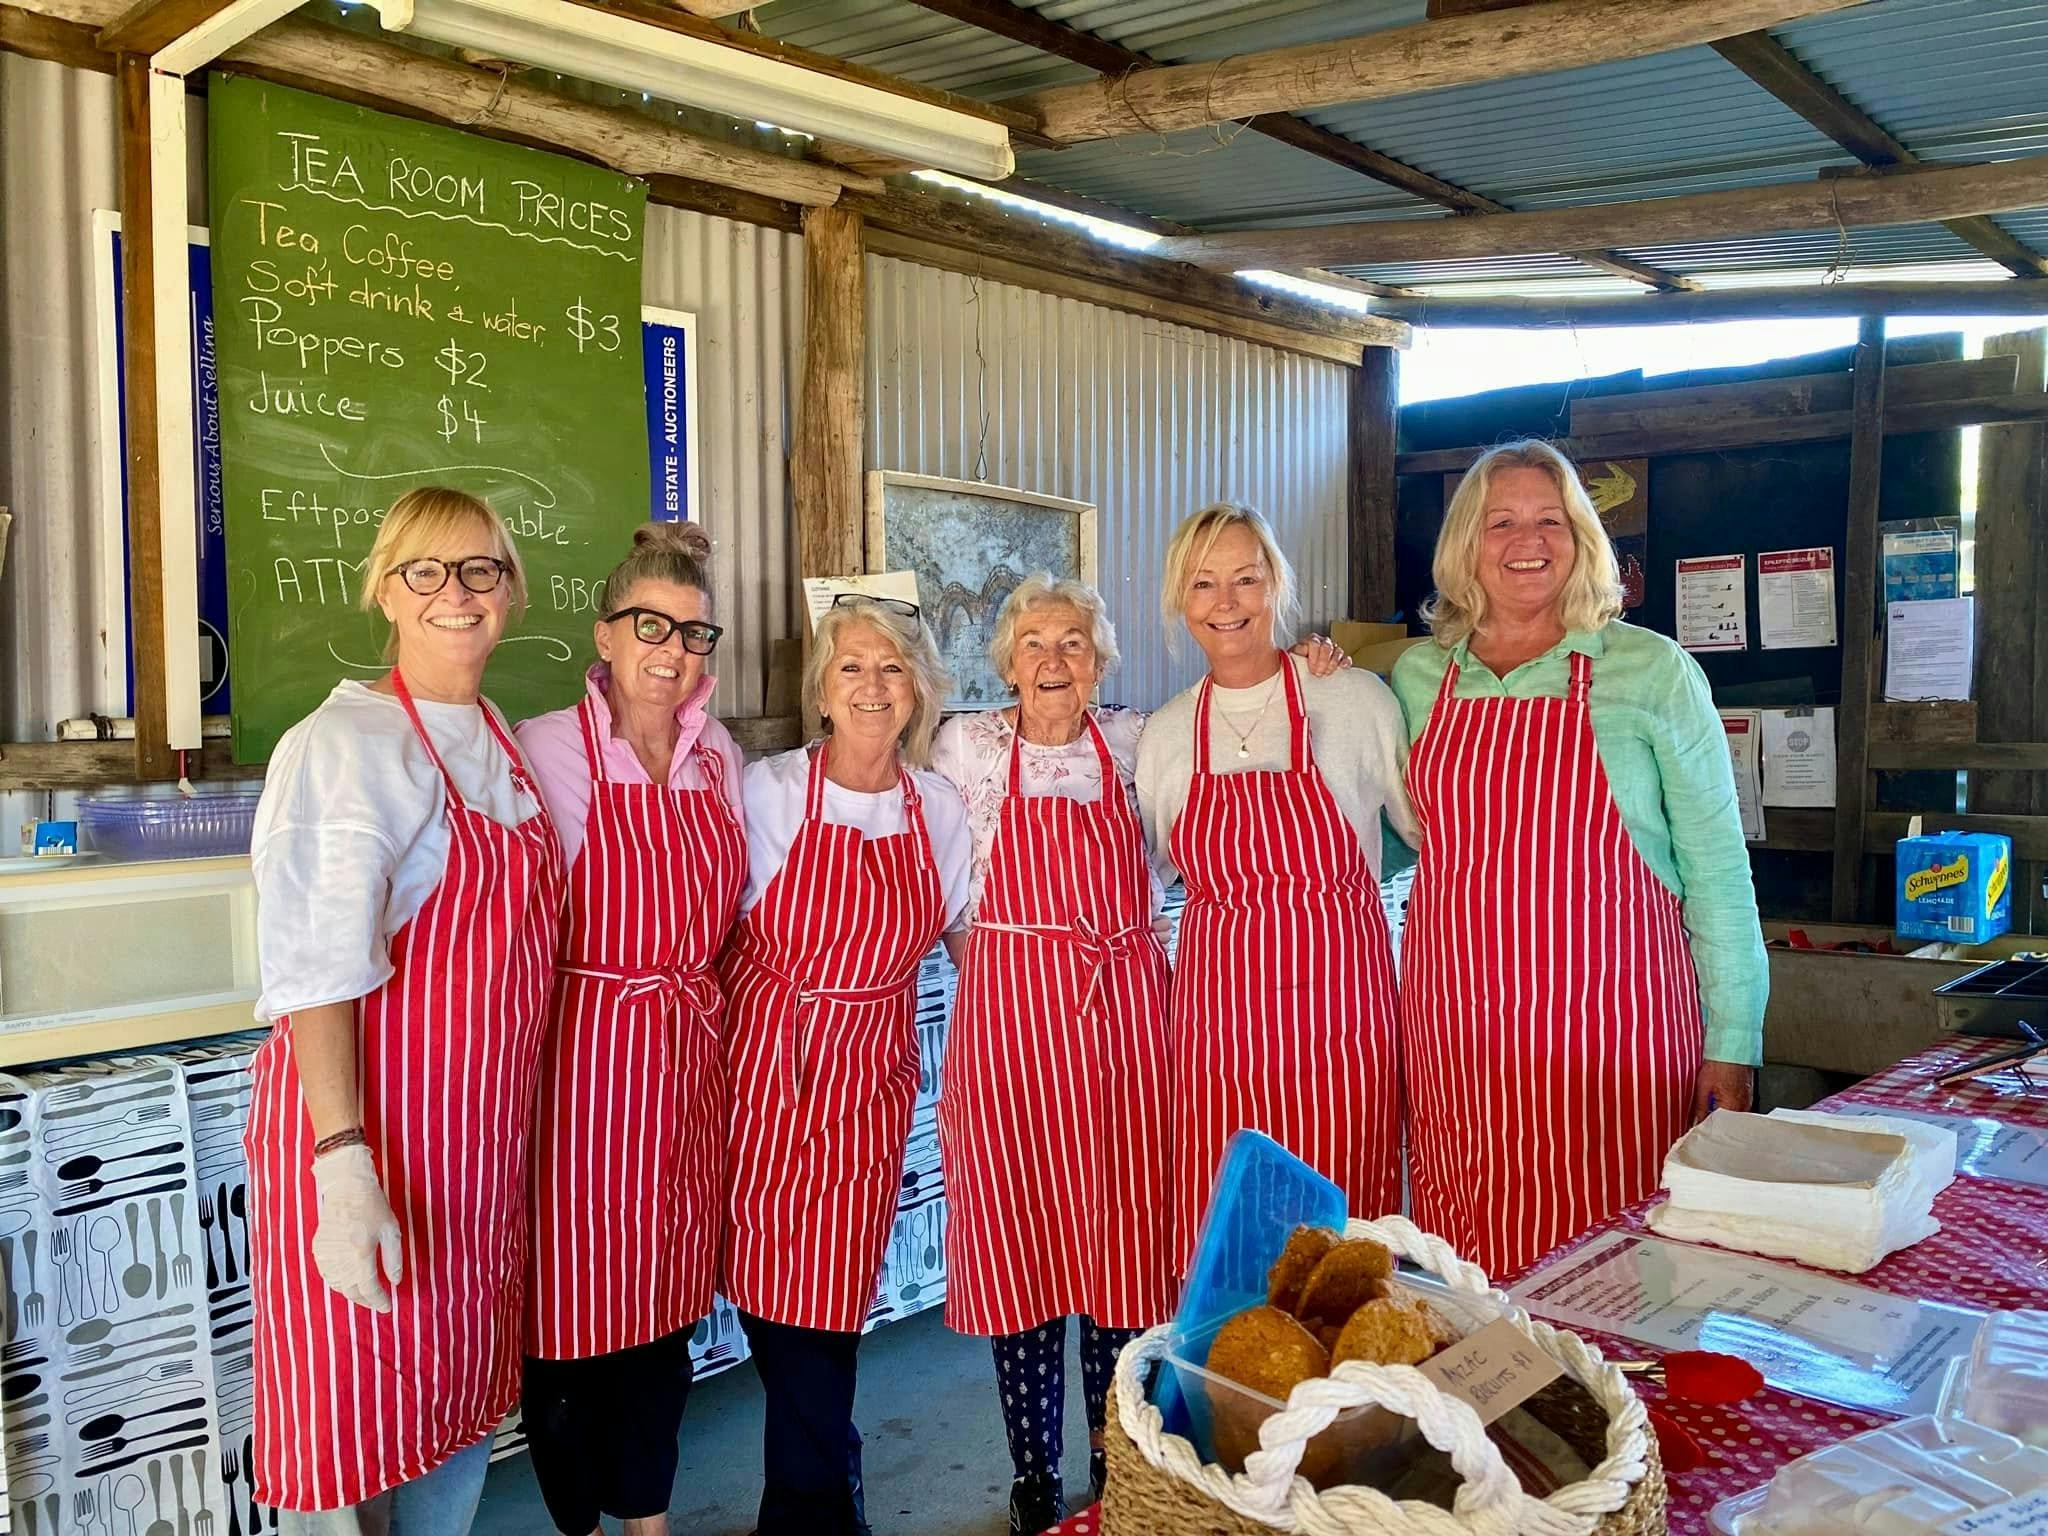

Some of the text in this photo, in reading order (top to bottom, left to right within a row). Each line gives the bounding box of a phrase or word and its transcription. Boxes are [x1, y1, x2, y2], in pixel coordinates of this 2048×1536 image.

[278, 132, 632, 241] TEA ROOM PRICES
[246, 260, 339, 306] Soft
[349, 277, 435, 321] drink
[239, 296, 405, 375] Poppers
[202, 392, 221, 458] About
[249, 370, 487, 443] Juice $4
[663, 336, 677, 444] AUCTIONEERS
[208, 461, 223, 536] Serious
[665, 455, 679, 511] ESTATE
